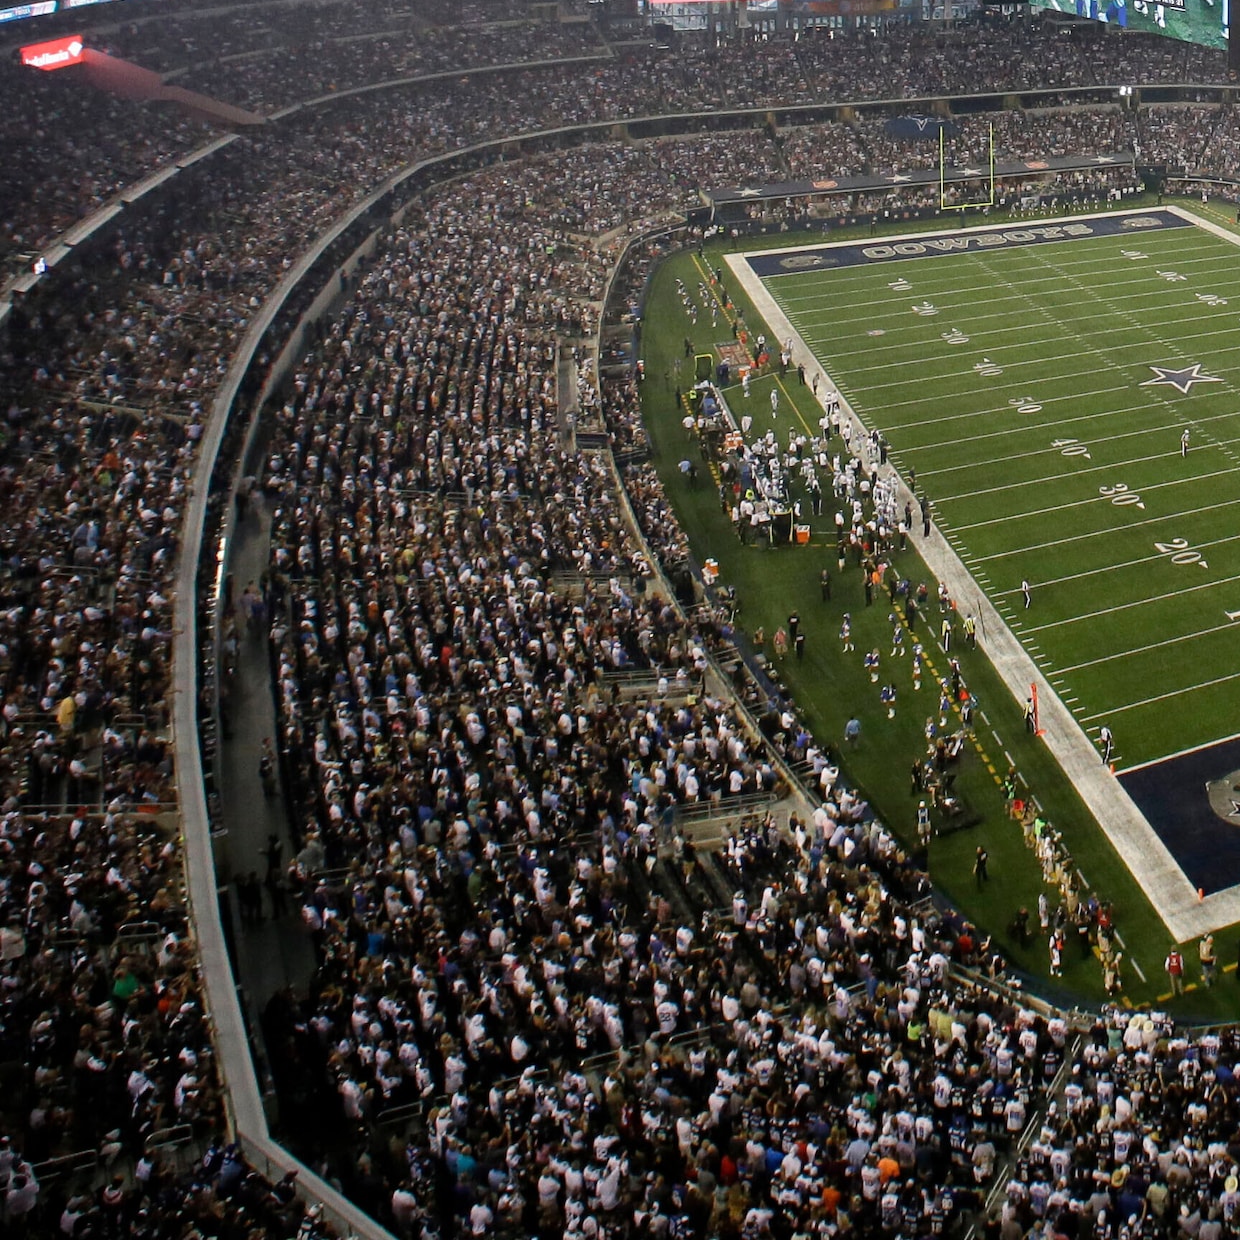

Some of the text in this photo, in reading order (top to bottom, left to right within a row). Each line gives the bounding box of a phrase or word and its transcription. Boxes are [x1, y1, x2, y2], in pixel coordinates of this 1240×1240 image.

[862, 223, 1094, 260] COWBOYS
[941, 330, 969, 345] 30
[1008, 396, 1043, 414] 50
[1050, 438, 1088, 456] 40
[1099, 483, 1140, 506] 30
[1154, 537, 1202, 565] 20
